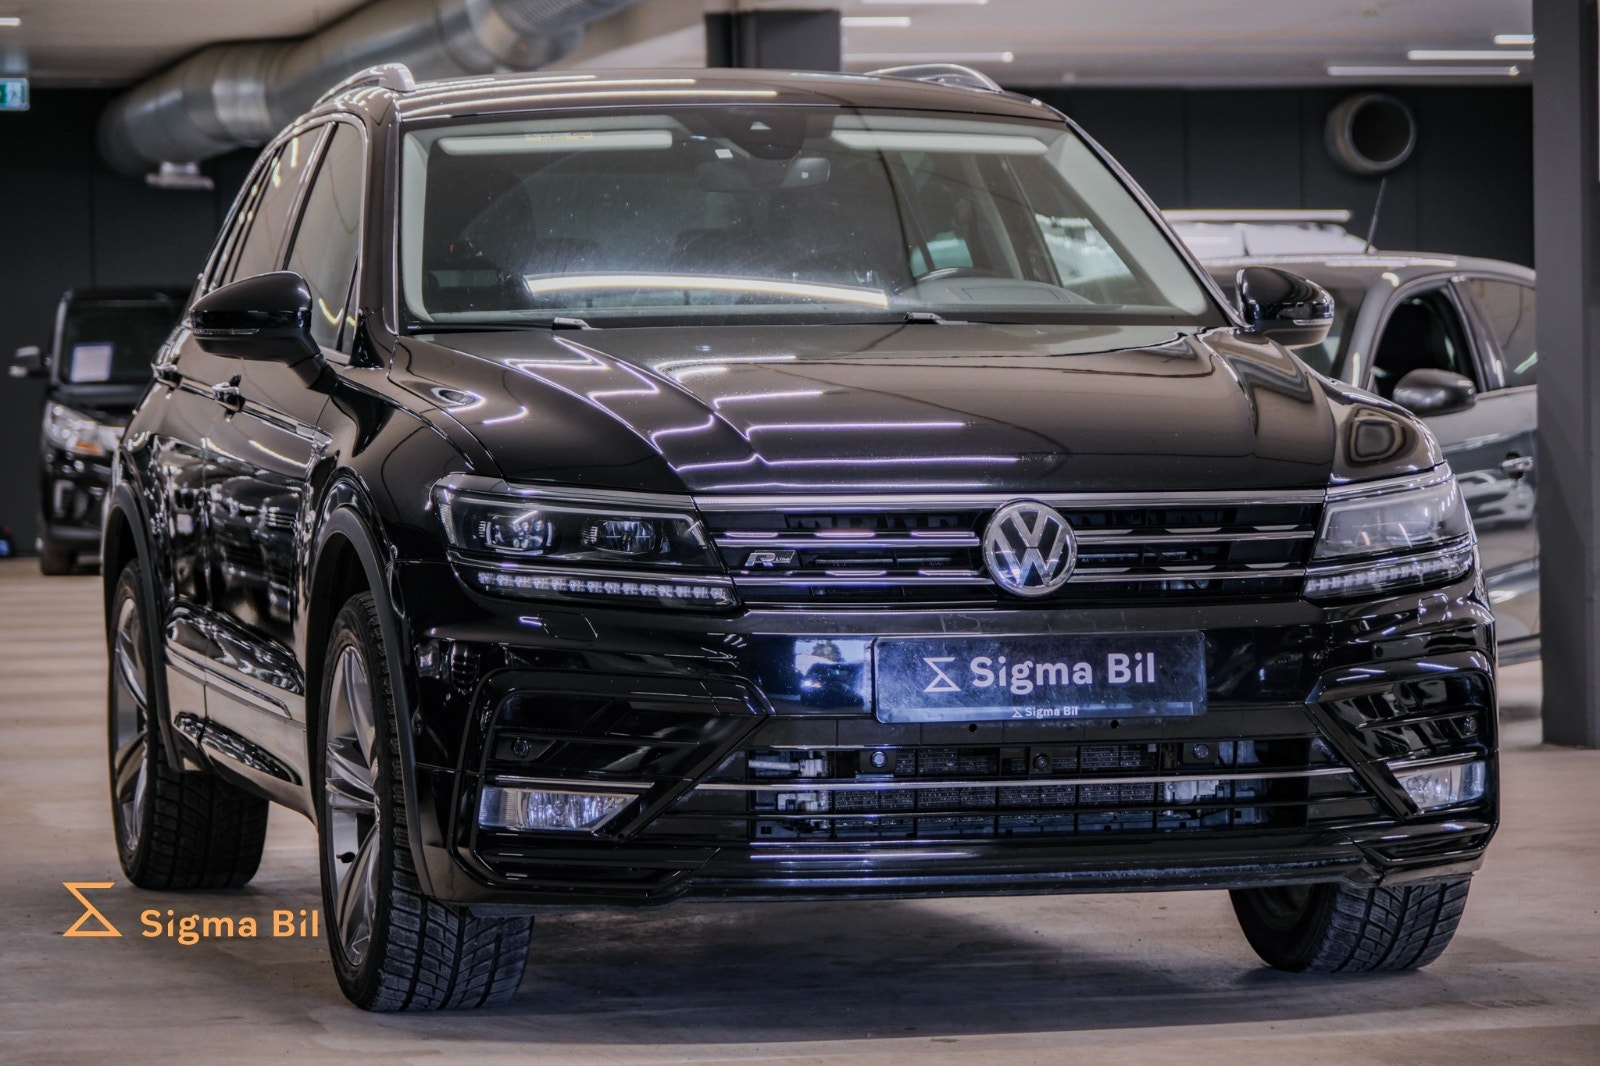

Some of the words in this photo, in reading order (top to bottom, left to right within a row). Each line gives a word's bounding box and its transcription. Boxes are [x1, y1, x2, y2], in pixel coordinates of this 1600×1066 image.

[969, 655, 1093, 695] Sigma
[1107, 652, 1155, 684] Bil
[1025, 706, 1060, 719] Sigma
[1063, 706, 1079, 716] Bil
